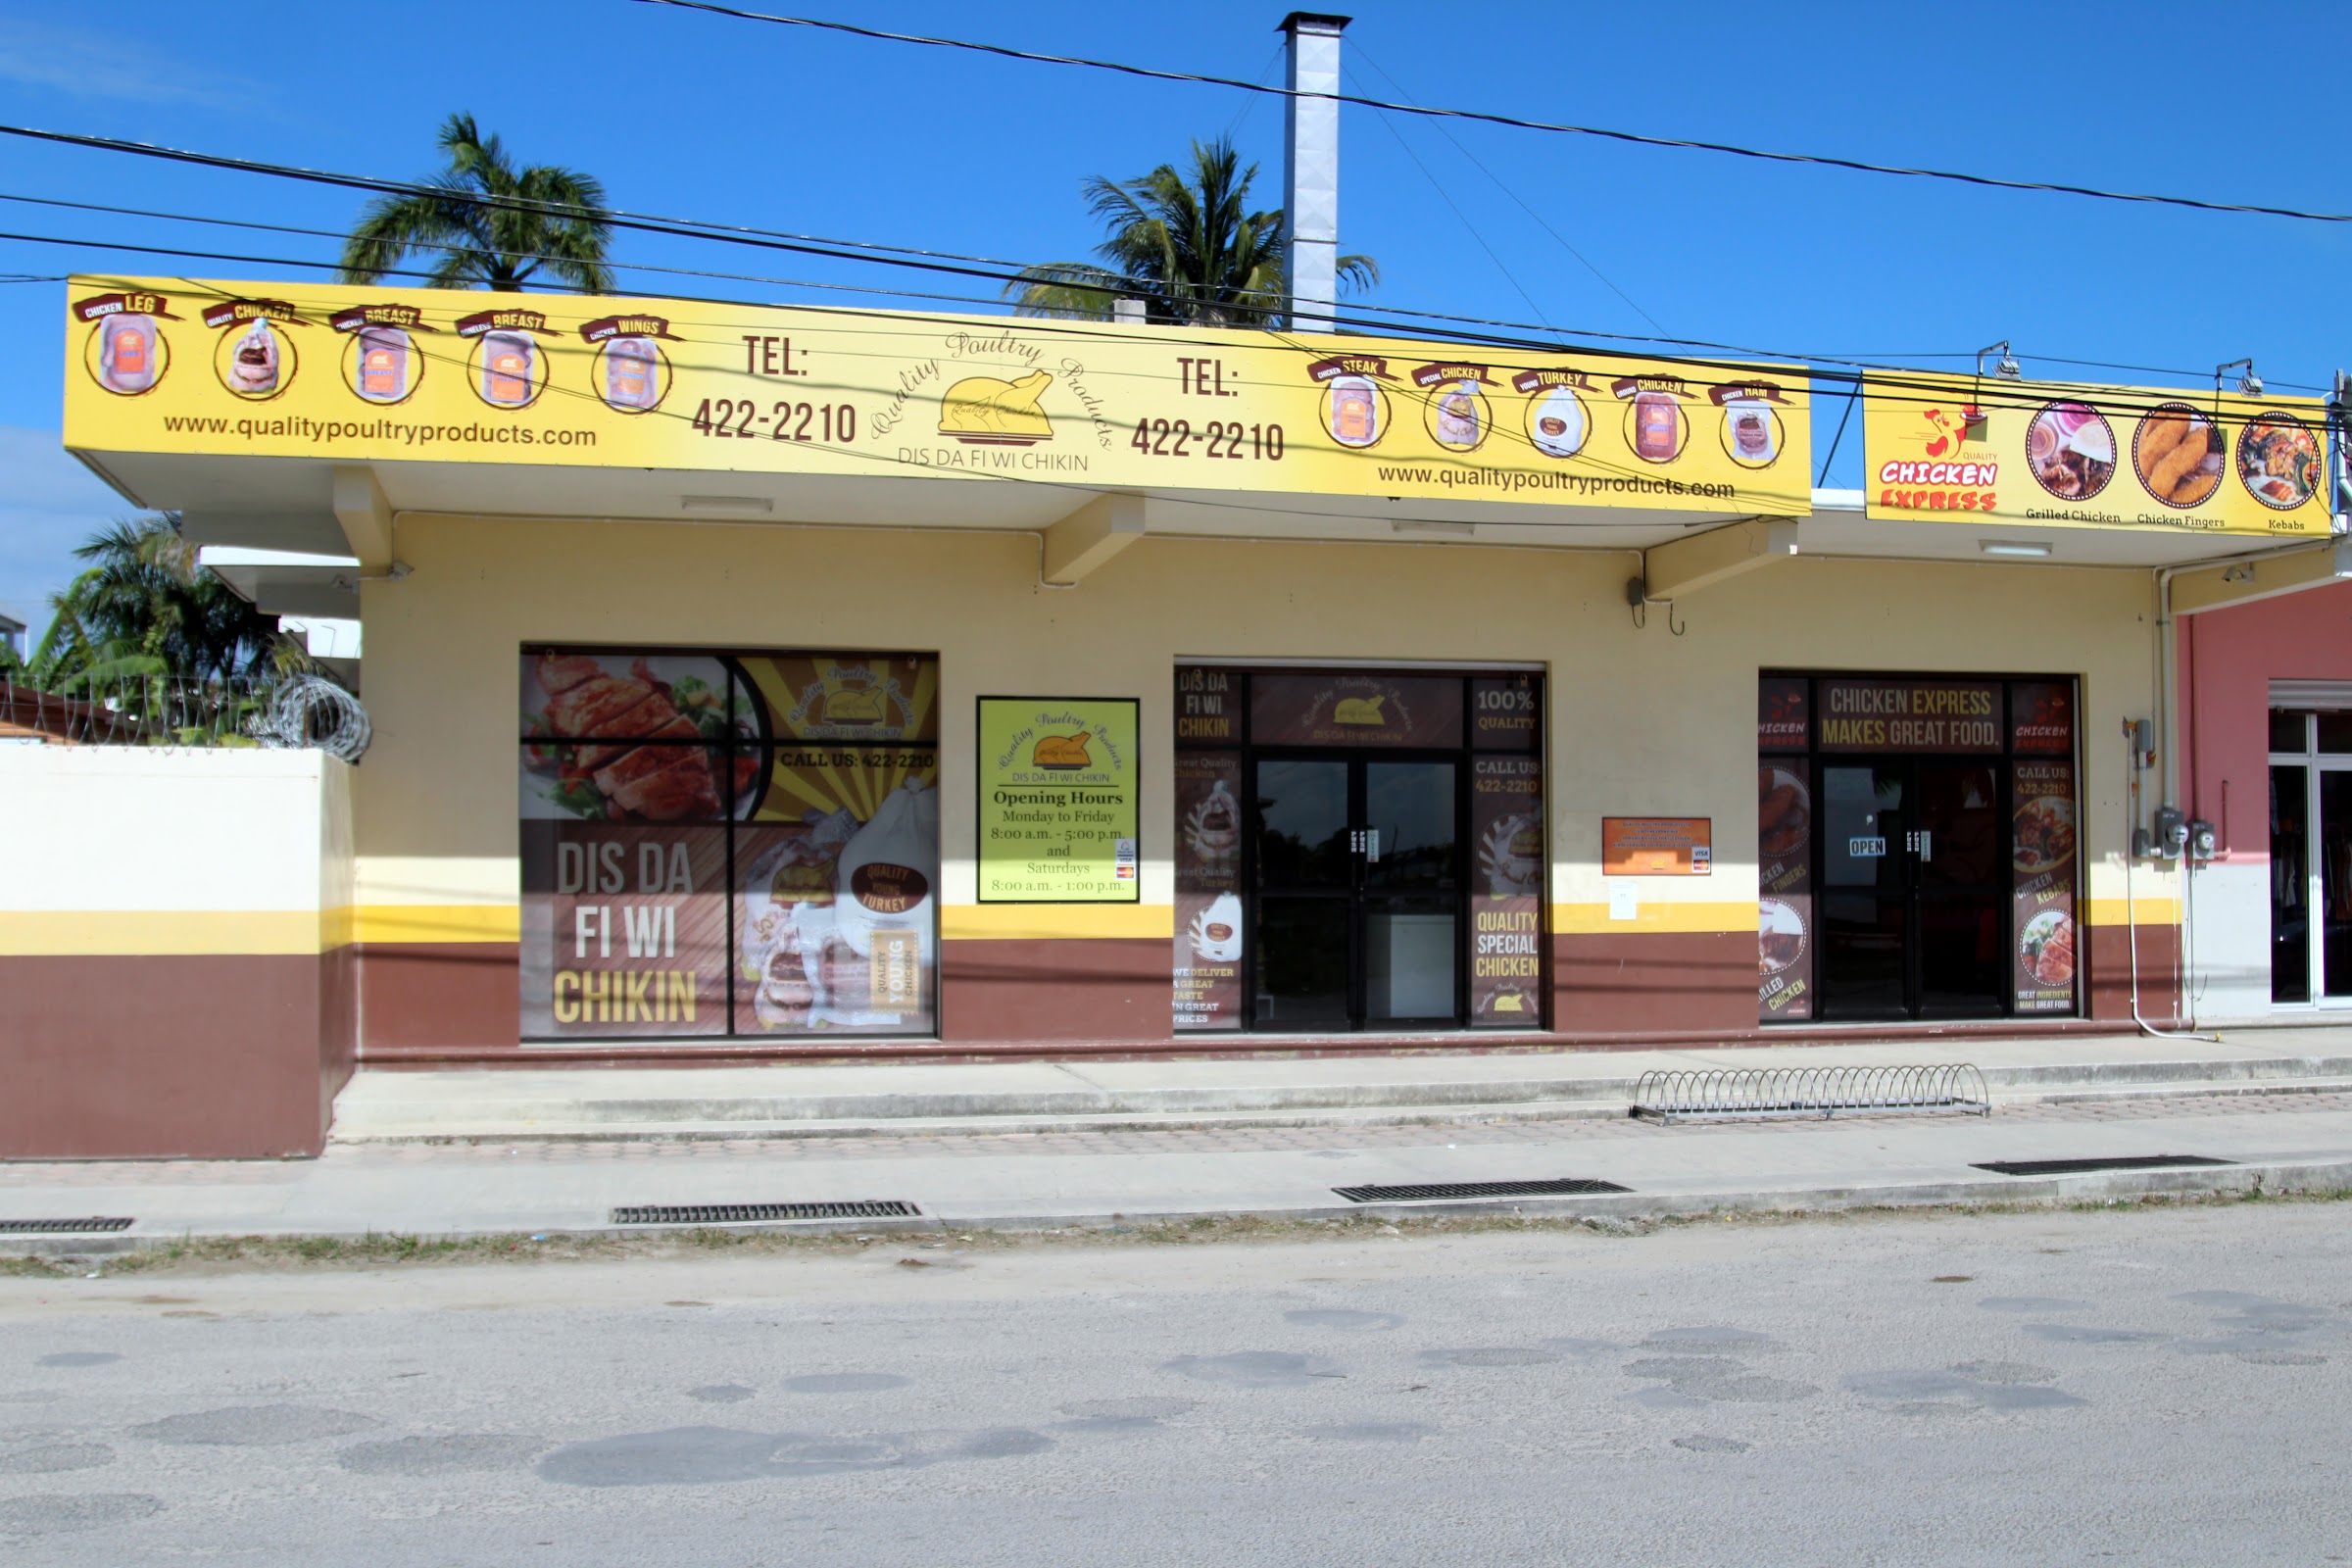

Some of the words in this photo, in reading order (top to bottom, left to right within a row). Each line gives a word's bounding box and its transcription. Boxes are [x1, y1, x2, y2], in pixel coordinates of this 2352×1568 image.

[85, 302, 122, 318] CHICKEN
[124, 294, 156, 314] LEG
[207, 313, 233, 327] QUALITY
[234, 302, 291, 321] CHICKEN
[365, 308, 416, 325] BREAST
[461, 322, 491, 336] BONELESS
[492, 314, 543, 329] BREAST
[589, 327, 617, 340] CHICKEN
[617, 319, 660, 334] WINGS
[742, 335, 808, 376] TEL:
[1176, 357, 1238, 397] TEL:
[1317, 367, 1342, 379] CHICKEN
[1343, 360, 1379, 374] STEAK
[1420, 372, 1442, 385] SPECIAL
[1441, 367, 1482, 381] CHICKEN
[870, 358, 940, 440] Quality
[945, 330, 1044, 367] Poultry
[1057, 358, 1112, 451] Products
[1520, 379, 1539, 391] YOUNG
[1537, 371, 1583, 386] TURKEY
[1616, 386, 1637, 398] GROUND
[1637, 378, 1683, 393] CHICKEN
[1721, 390, 1743, 401] CHICKEN
[1744, 384, 1768, 397] HAM
[692, 398, 856, 443] 422-2210
[164, 416, 596, 448] www.qualitypoultryproducts.com
[1131, 417, 1284, 461] 422-2210
[899, 447, 929, 466] DIS
[936, 449, 964, 466] DA
[971, 451, 986, 467] FI
[992, 452, 1015, 468] WI
[1021, 453, 1088, 471] CHIKIN
[1963, 452, 1997, 462] QUALITY
[1378, 466, 1735, 498] www.qualitypoultryproducts.com
[1880, 461, 1998, 487] CHICKEN
[1881, 489, 1997, 511] EXPRESS
[2026, 509, 2070, 521] Grilled
[2072, 511, 2121, 522] Chicken
[2137, 514, 2183, 525] Chicken
[2184, 515, 2225, 528] Fingers
[2269, 519, 2305, 530] Kebabs
[1179, 672, 1203, 692] DIS
[1207, 673, 1229, 692] DA
[1186, 695, 1200, 714] FI
[1202, 695, 1222, 714] WI
[1478, 690, 1535, 710] 100%
[1831, 688, 1908, 714] CHICKEN
[1913, 690, 1991, 715] EXPRESS
[1035, 711, 1087, 729] Poultry
[1178, 717, 1230, 738] CHIKIN
[1478, 716, 1536, 730] QUALITY
[1757, 722, 1805, 733] HICKEN
[1822, 719, 1886, 745] MAKES
[1889, 720, 1945, 746] GREAT
[1950, 721, 1999, 747] FOOD.
[2016, 726, 2068, 737] CHICKEN
[781, 753, 828, 767] CALL
[832, 754, 858, 767] US:
[862, 754, 934, 767] 422-2210
[1174, 759, 1200, 768] reat
[1200, 758, 1237, 770] Quality
[1476, 761, 1515, 774] CALL
[1012, 772, 1029, 782] DIS
[1032, 772, 1046, 782] DA
[1050, 773, 1057, 782] FI
[1059, 773, 1073, 782] WI
[1075, 773, 1109, 782] CHIKIN
[2017, 766, 2049, 779] CALL
[2051, 767, 2070, 779] US:
[1476, 780, 1538, 793] 422-2210
[2017, 783, 2066, 795] 422-2210
[994, 791, 1066, 808] Opening
[1071, 792, 1123, 805] Hours
[1003, 810, 1054, 825] Monday
[1058, 811, 1071, 822] to
[1074, 810, 1115, 825] Friday
[991, 828, 1021, 840] 8:00
[1025, 831, 1053, 840] a.m.
[1064, 830, 1095, 842] 5:00
[1098, 830, 1126, 843] p.m.
[1047, 845, 1070, 857] and
[1851, 840, 1884, 855] OPEN
[558, 843, 624, 896] DIS
[639, 843, 693, 896] DA
[867, 864, 910, 881] QUALITY
[1027, 862, 1090, 876] Saturdays
[1772, 863, 1807, 894] FINGERS
[872, 883, 901, 896] YOUNG
[992, 880, 1022, 891] 8:00
[1025, 882, 1053, 891] a.m.
[1065, 882, 1094, 892] 1:00
[1098, 882, 1125, 894] p.m.
[2016, 872, 2053, 900] CHICKEN
[2035, 878, 2072, 906] KEBABS
[862, 893, 907, 911] TURKEY
[1478, 911, 1538, 932] QUALITY
[575, 906, 610, 958] FI
[623, 906, 675, 958] WI
[1478, 935, 1538, 955] SPECIAL
[877, 951, 887, 994] QUALITY
[889, 940, 905, 1004] YOUNG
[1172, 968, 1189, 977] WE
[1191, 968, 1234, 977] DELIVER
[1476, 957, 1539, 977] CHICKEN
[553, 971, 696, 1024] CHIKIN
[1768, 979, 1806, 1011] CHICKEN
[2018, 991, 2035, 1000] GREAT
[2036, 990, 2072, 1000] INGREDIENTS
[2019, 1001, 2035, 1009] MAKE
[2036, 1000, 2053, 1008] GREAT
[2054, 1000, 2070, 1008] FOOD.
